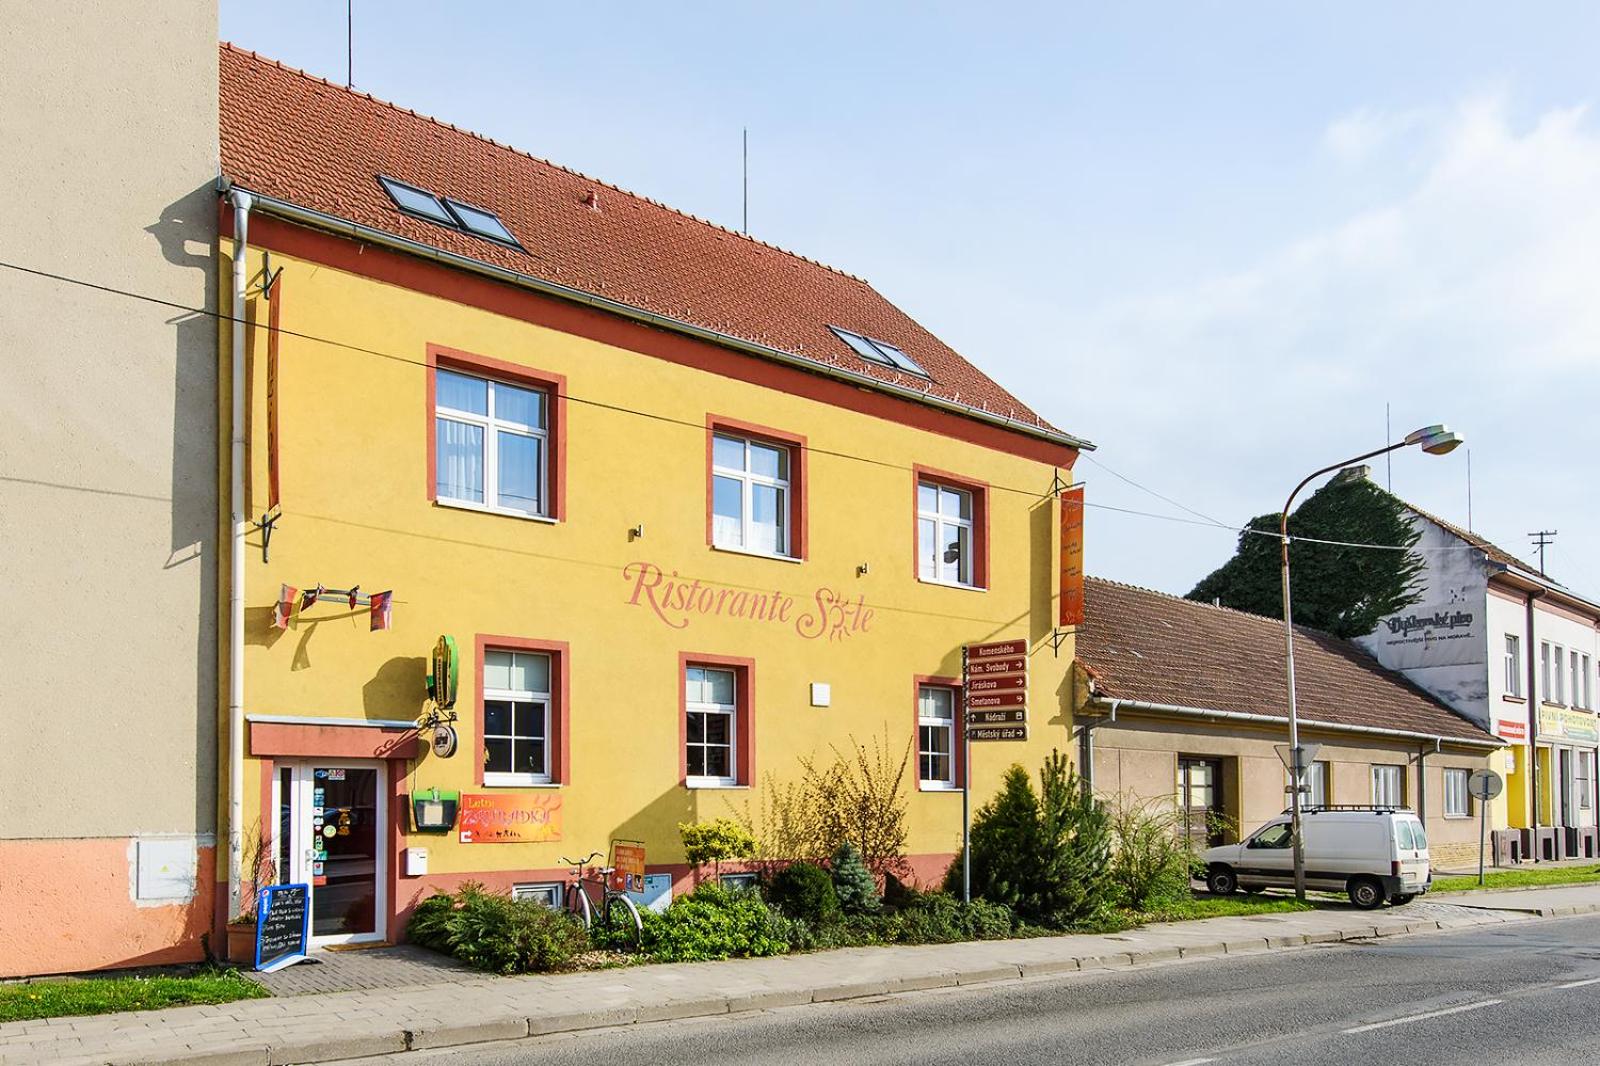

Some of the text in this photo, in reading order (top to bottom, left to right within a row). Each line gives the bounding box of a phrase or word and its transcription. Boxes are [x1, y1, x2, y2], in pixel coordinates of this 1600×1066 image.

[623, 562, 793, 629] Ristorante
[1450, 611, 1473, 629] pivo
[979, 645, 1015, 655] Komenského
[985, 662, 1009, 673] Svobody
[971, 681, 997, 690] Jiráskova
[971, 697, 1001, 706] Smetanova
[985, 712, 1006, 721] Nádraží
